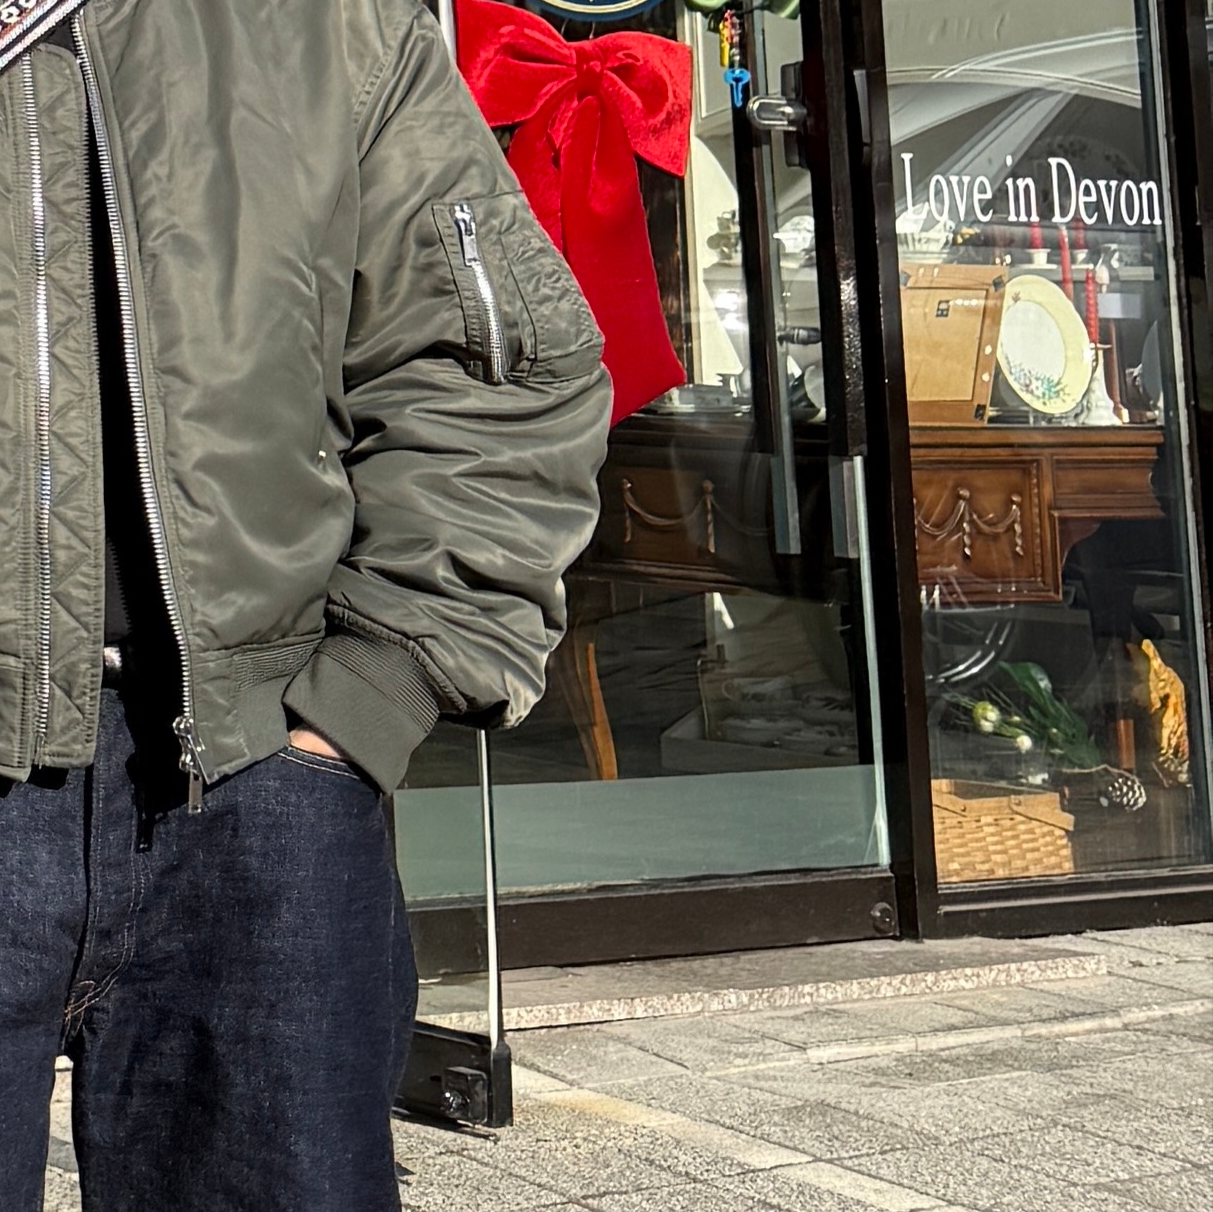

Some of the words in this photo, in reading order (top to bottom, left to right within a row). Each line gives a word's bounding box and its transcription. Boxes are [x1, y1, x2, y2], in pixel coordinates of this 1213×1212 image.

[900, 153, 994, 223] Love
[1005, 154, 1040, 222] in
[1047, 157, 1162, 226] Devon
